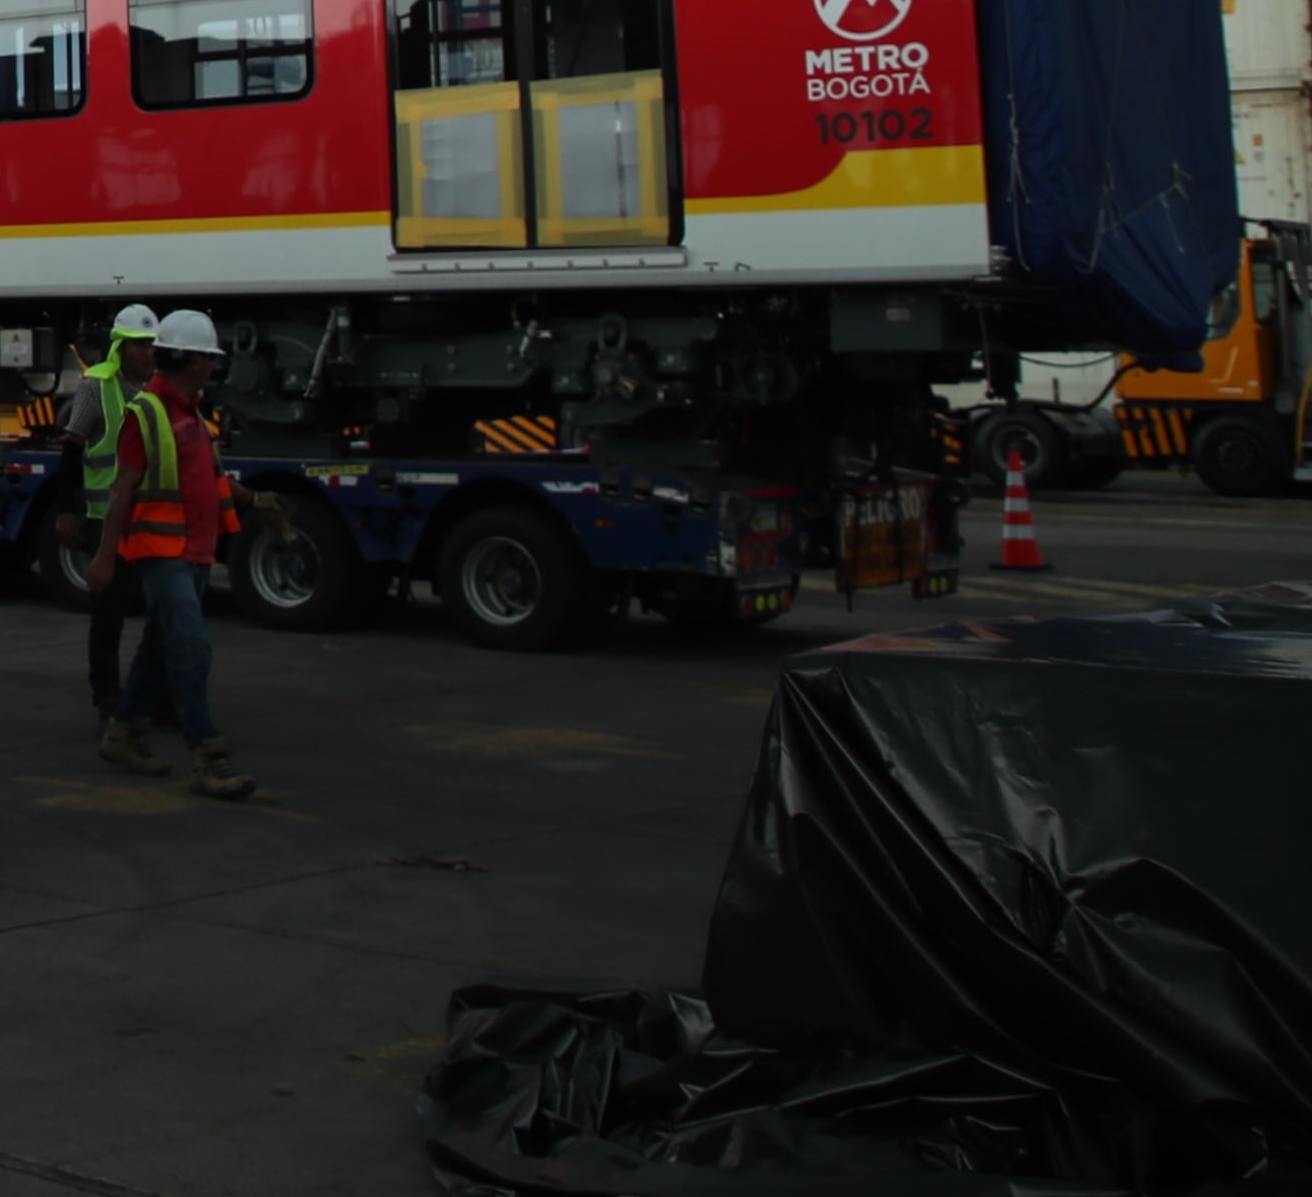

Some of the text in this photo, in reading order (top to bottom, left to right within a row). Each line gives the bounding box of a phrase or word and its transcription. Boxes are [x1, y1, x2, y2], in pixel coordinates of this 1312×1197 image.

[804, 42, 930, 76] METRO
[806, 67, 932, 102] BOGOTÁ
[815, 108, 933, 144] 10102
